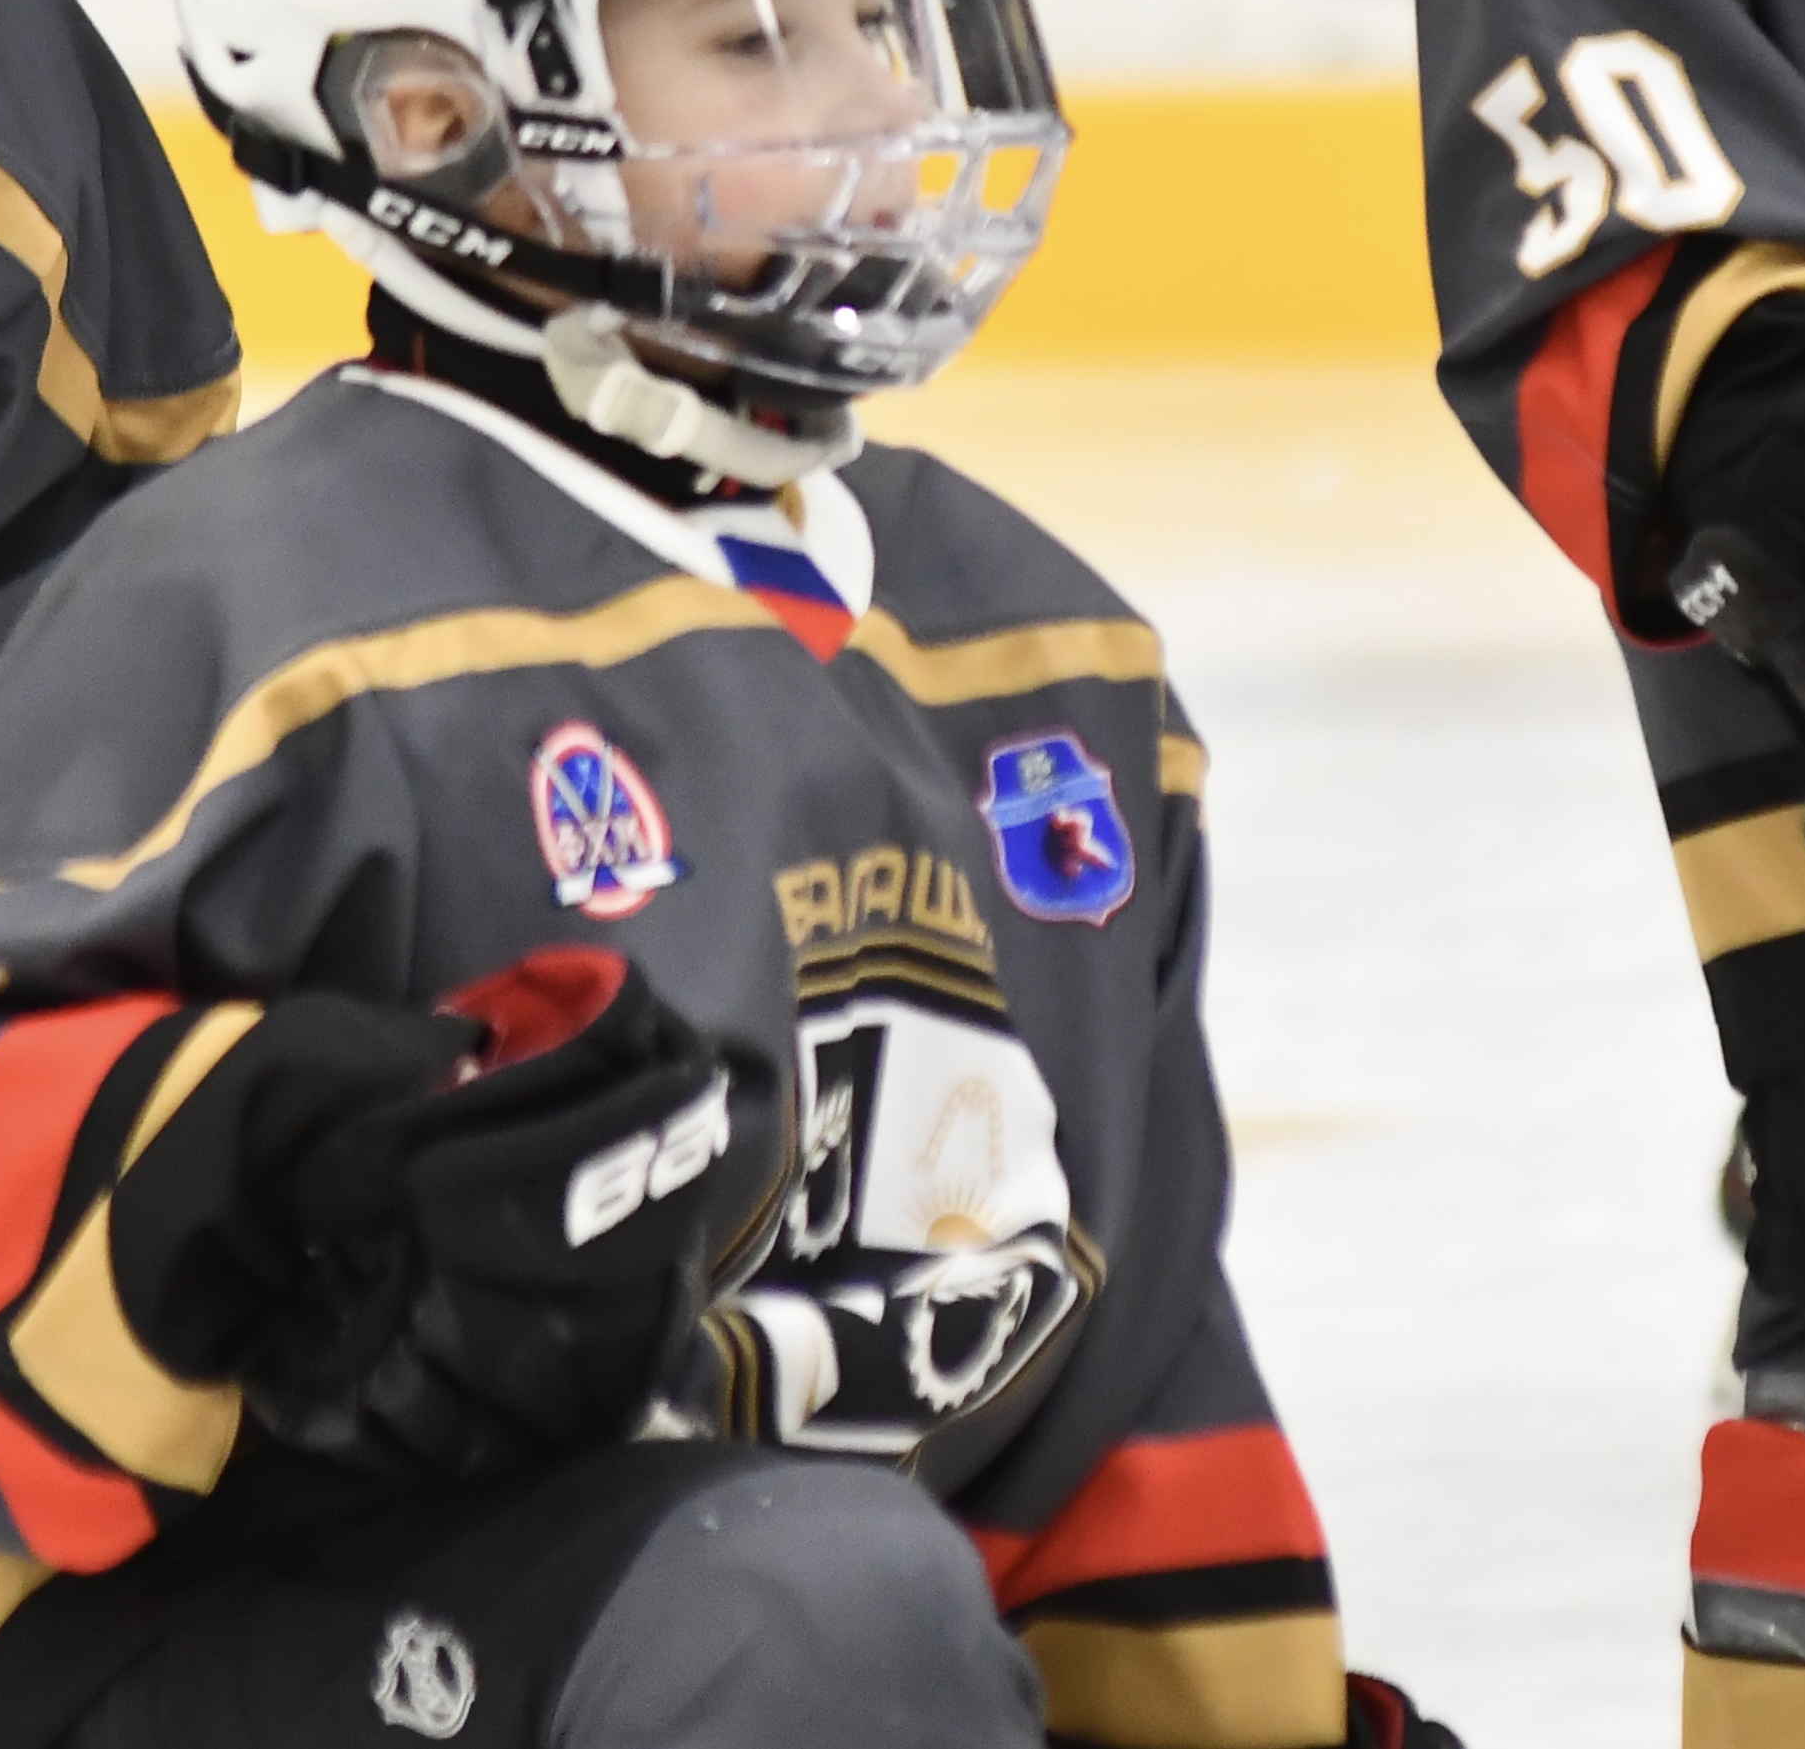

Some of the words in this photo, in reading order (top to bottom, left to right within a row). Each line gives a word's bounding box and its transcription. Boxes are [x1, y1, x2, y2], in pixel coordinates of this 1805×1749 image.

[517, 120, 619, 157] CCM
[1471, 30, 1746, 279] 50
[366, 186, 514, 268] CCM
